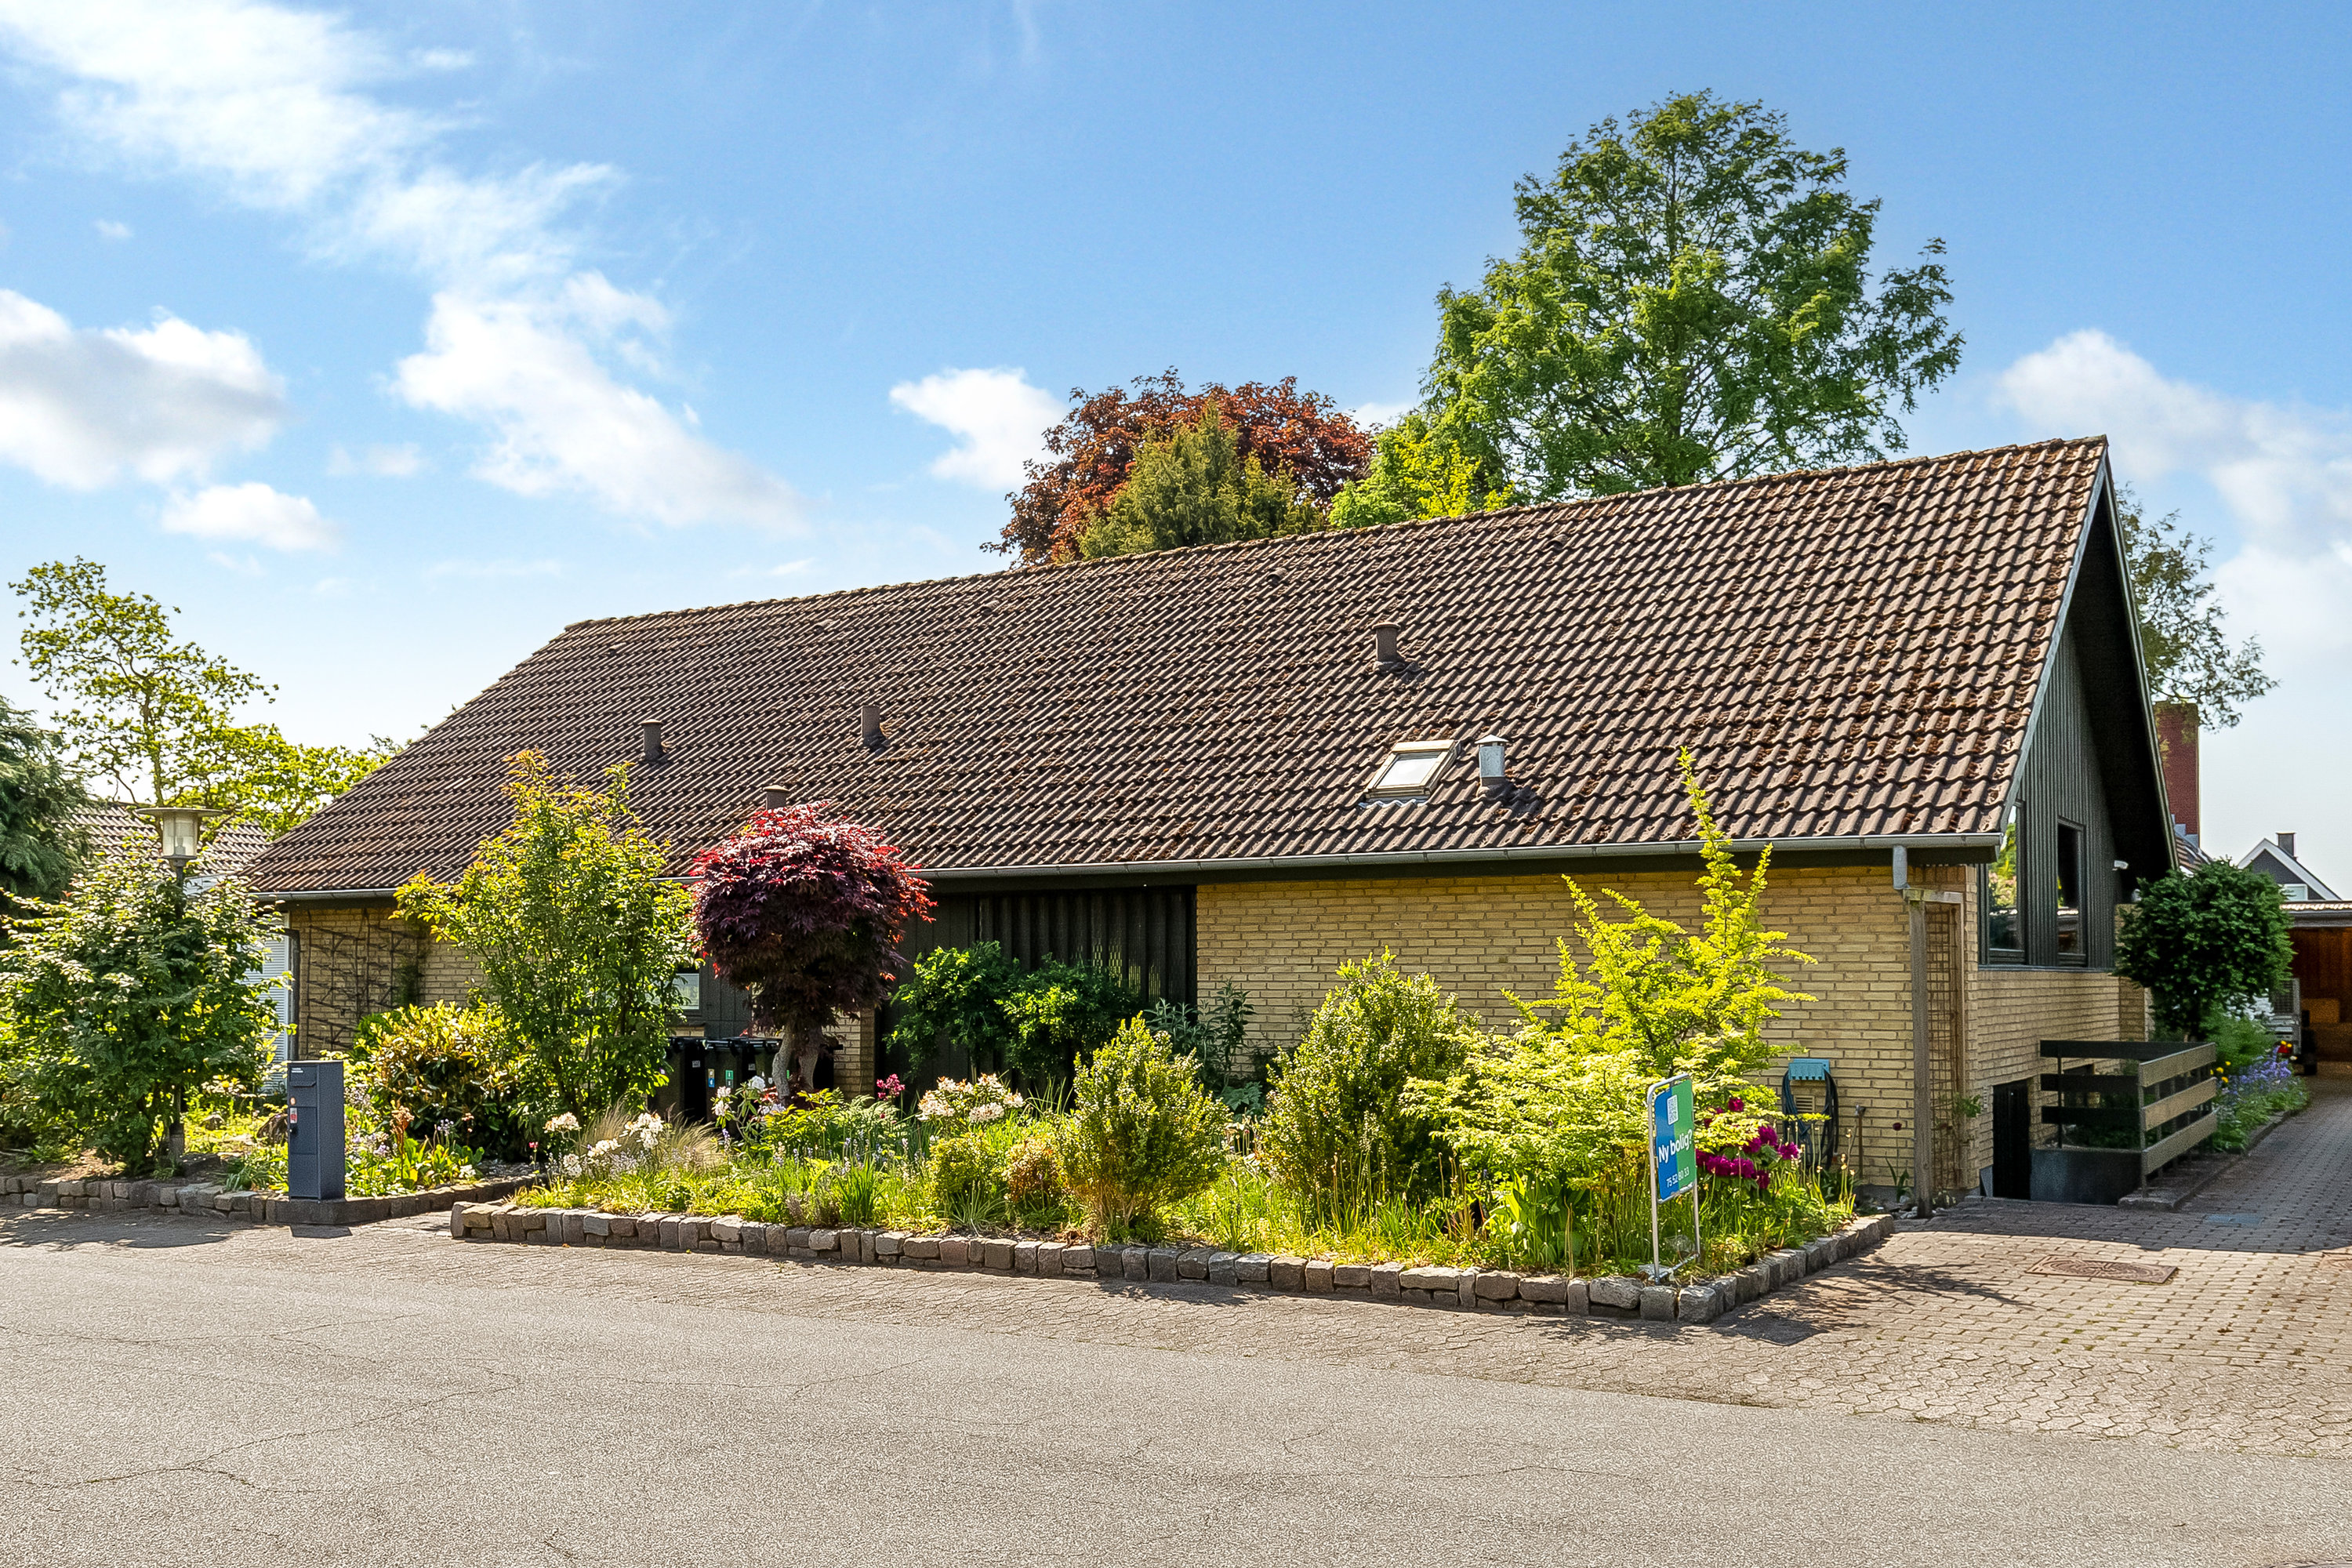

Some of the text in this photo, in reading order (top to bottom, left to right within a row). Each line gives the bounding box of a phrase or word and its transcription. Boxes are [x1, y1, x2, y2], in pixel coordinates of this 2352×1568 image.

[1658, 1129, 1693, 1163] Ny bolig?
[1666, 1177, 1672, 1188] 75
